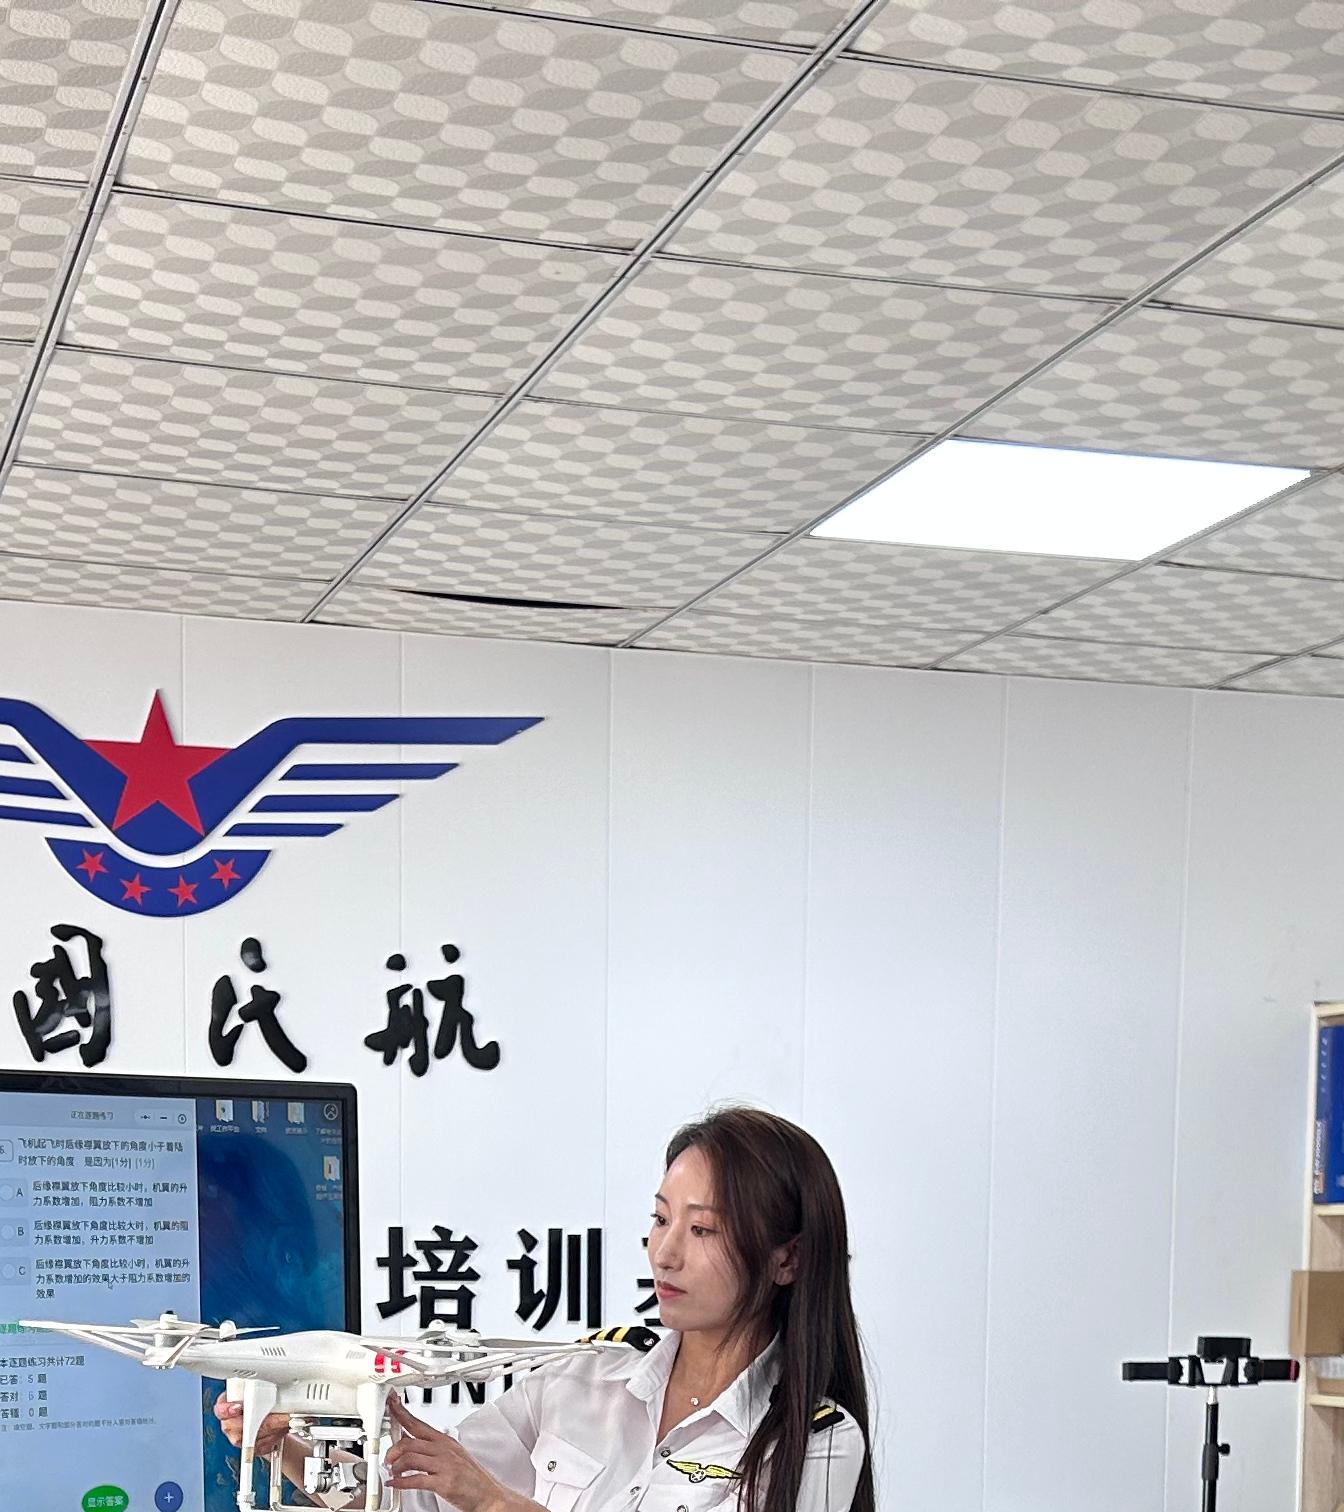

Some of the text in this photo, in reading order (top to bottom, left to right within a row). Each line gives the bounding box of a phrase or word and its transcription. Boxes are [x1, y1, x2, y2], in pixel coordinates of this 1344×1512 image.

[36, 1288, 55, 1299] 效果
[0, 1356, 85, 1368] 本逐题练习共计72题
[87, 1496, 124, 1508] 显示答案
